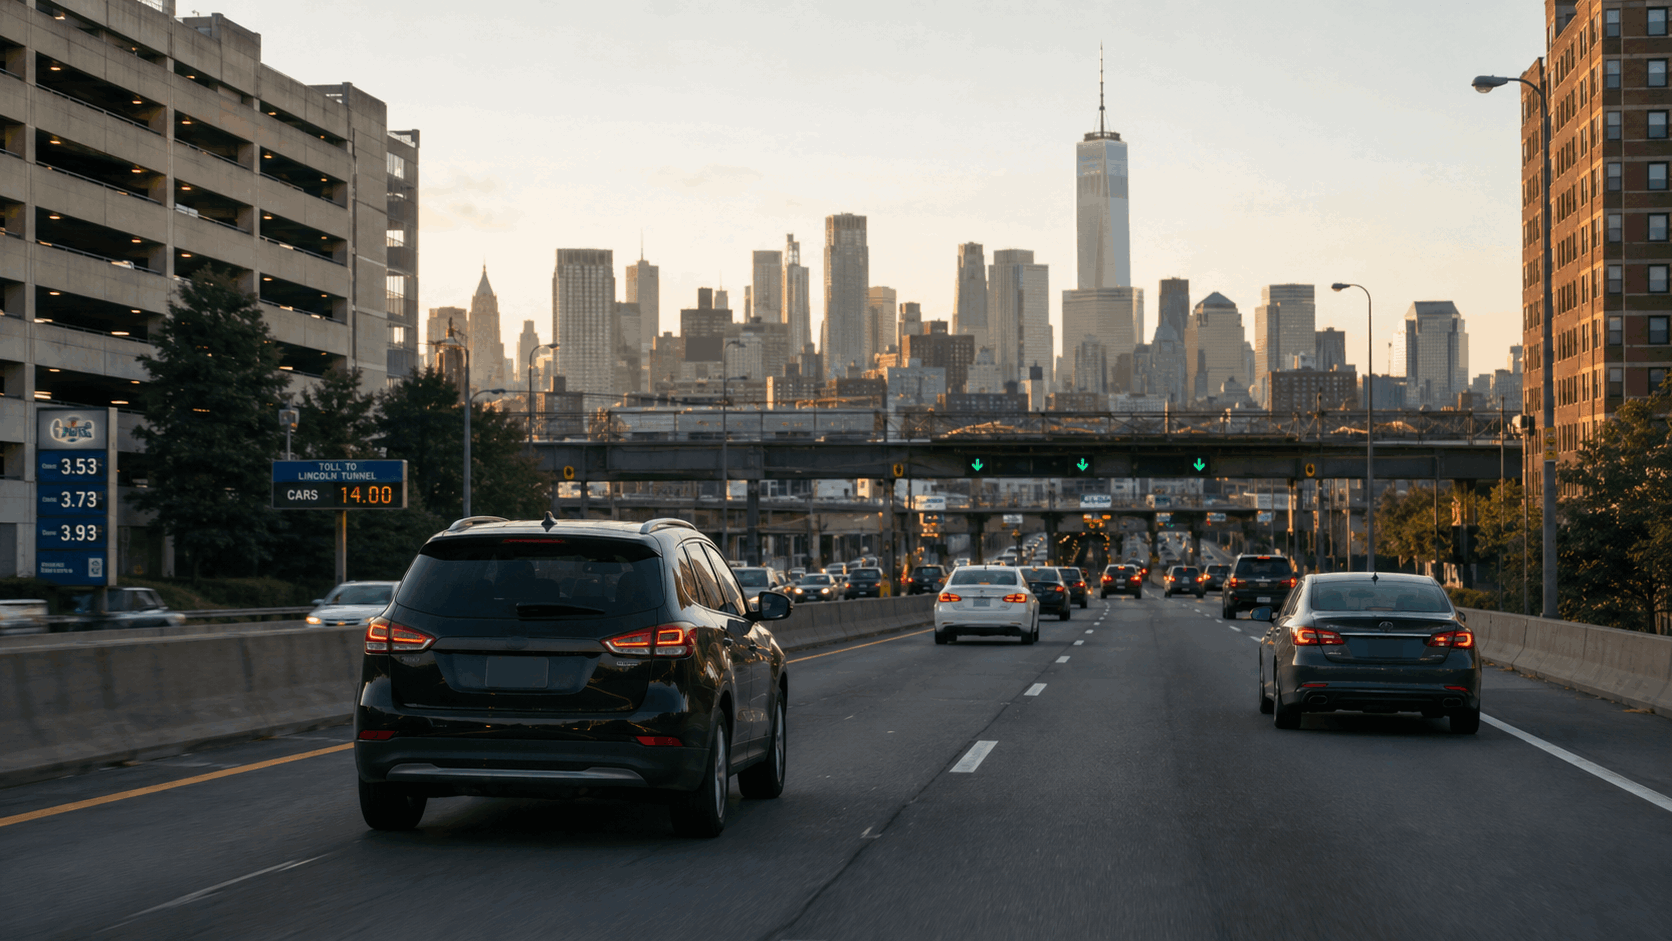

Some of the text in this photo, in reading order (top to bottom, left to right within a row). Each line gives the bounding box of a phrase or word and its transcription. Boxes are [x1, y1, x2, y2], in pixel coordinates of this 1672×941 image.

[61, 458, 97, 475] 3.53
[319, 462, 357, 471] TOLL TO
[298, 472, 376, 480] LINCOLN TUNNEL
[61, 491, 97, 508] 3.73
[287, 486, 392, 504] CARS 14.00
[61, 524, 97, 541] 3.93
